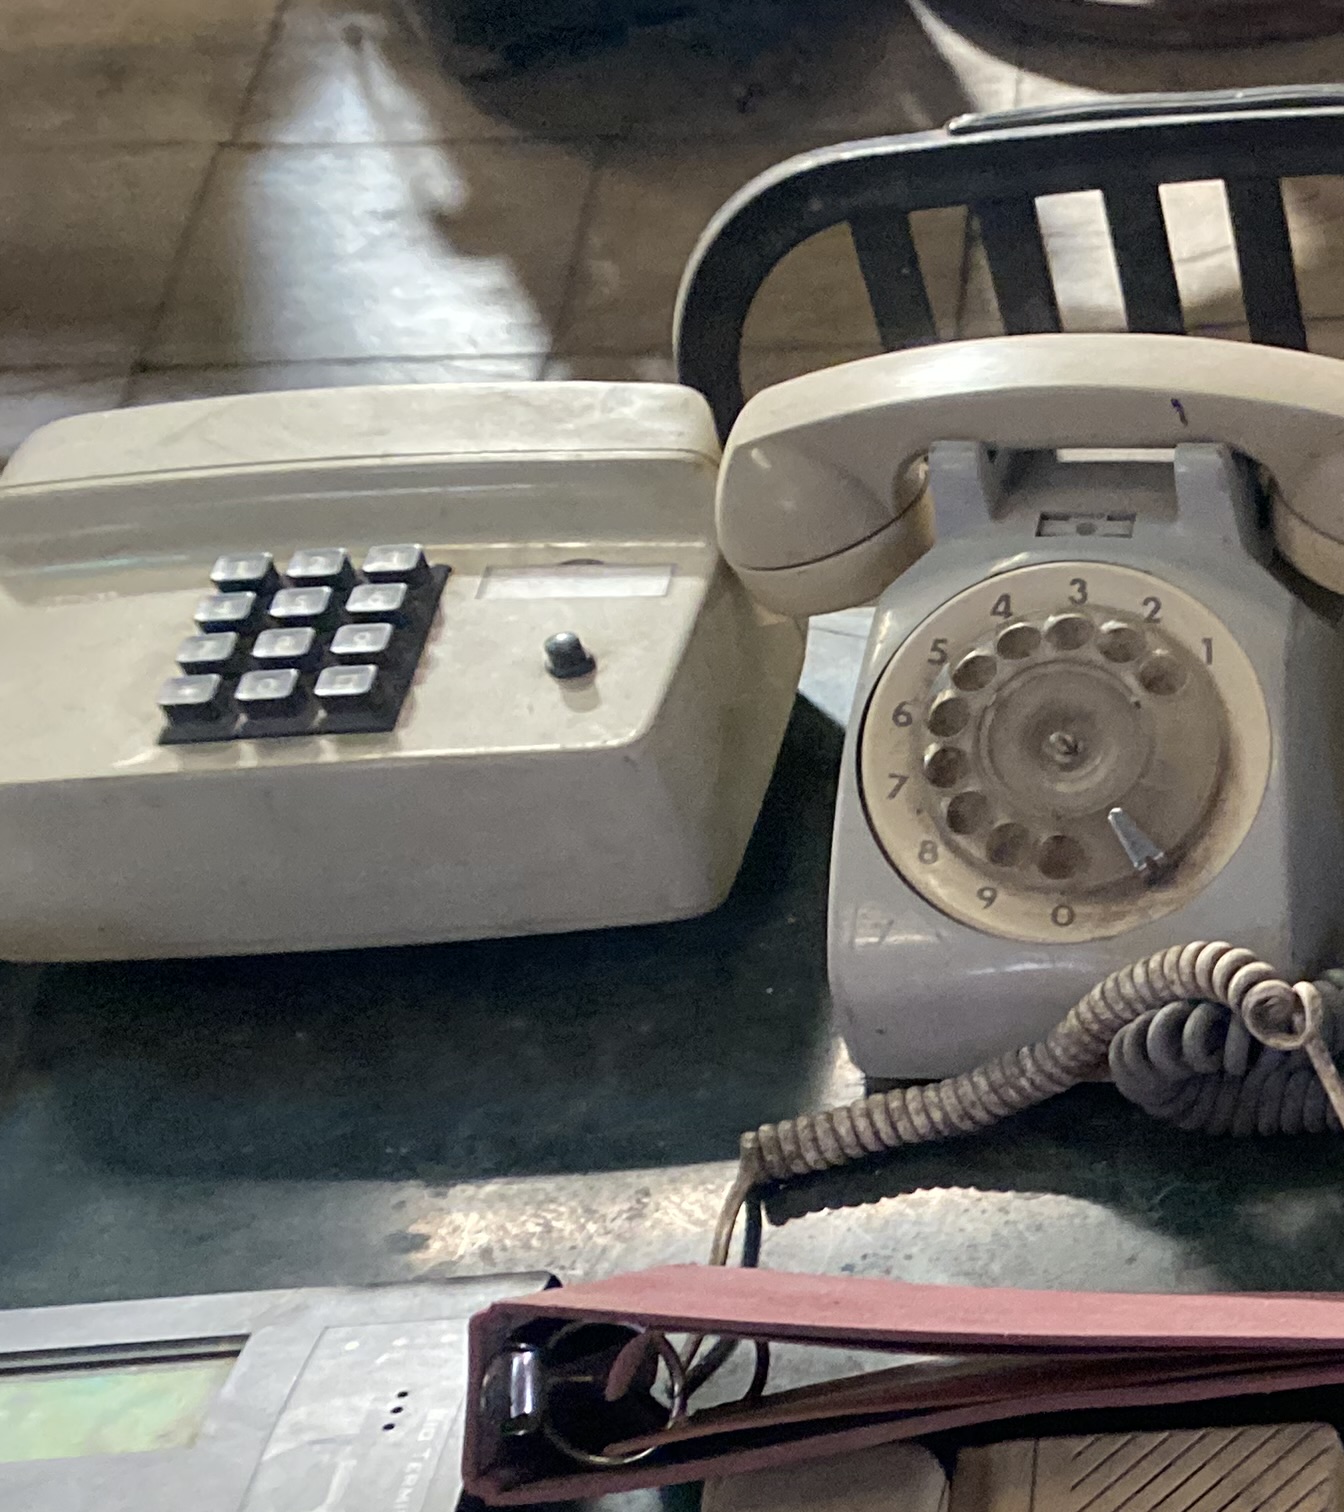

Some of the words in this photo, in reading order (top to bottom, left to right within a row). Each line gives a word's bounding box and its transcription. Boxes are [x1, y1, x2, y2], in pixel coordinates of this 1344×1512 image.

[1068, 578, 1088, 605] 3
[991, 594, 1013, 619] 4
[1142, 597, 1161, 624] 2
[927, 638, 947, 665] 5
[1200, 637, 1213, 665] 1
[892, 702, 913, 727] 6
[888, 773, 908, 799] 7
[918, 840, 939, 864] 8
[977, 887, 998, 909] 9
[1051, 905, 1075, 927] 0
